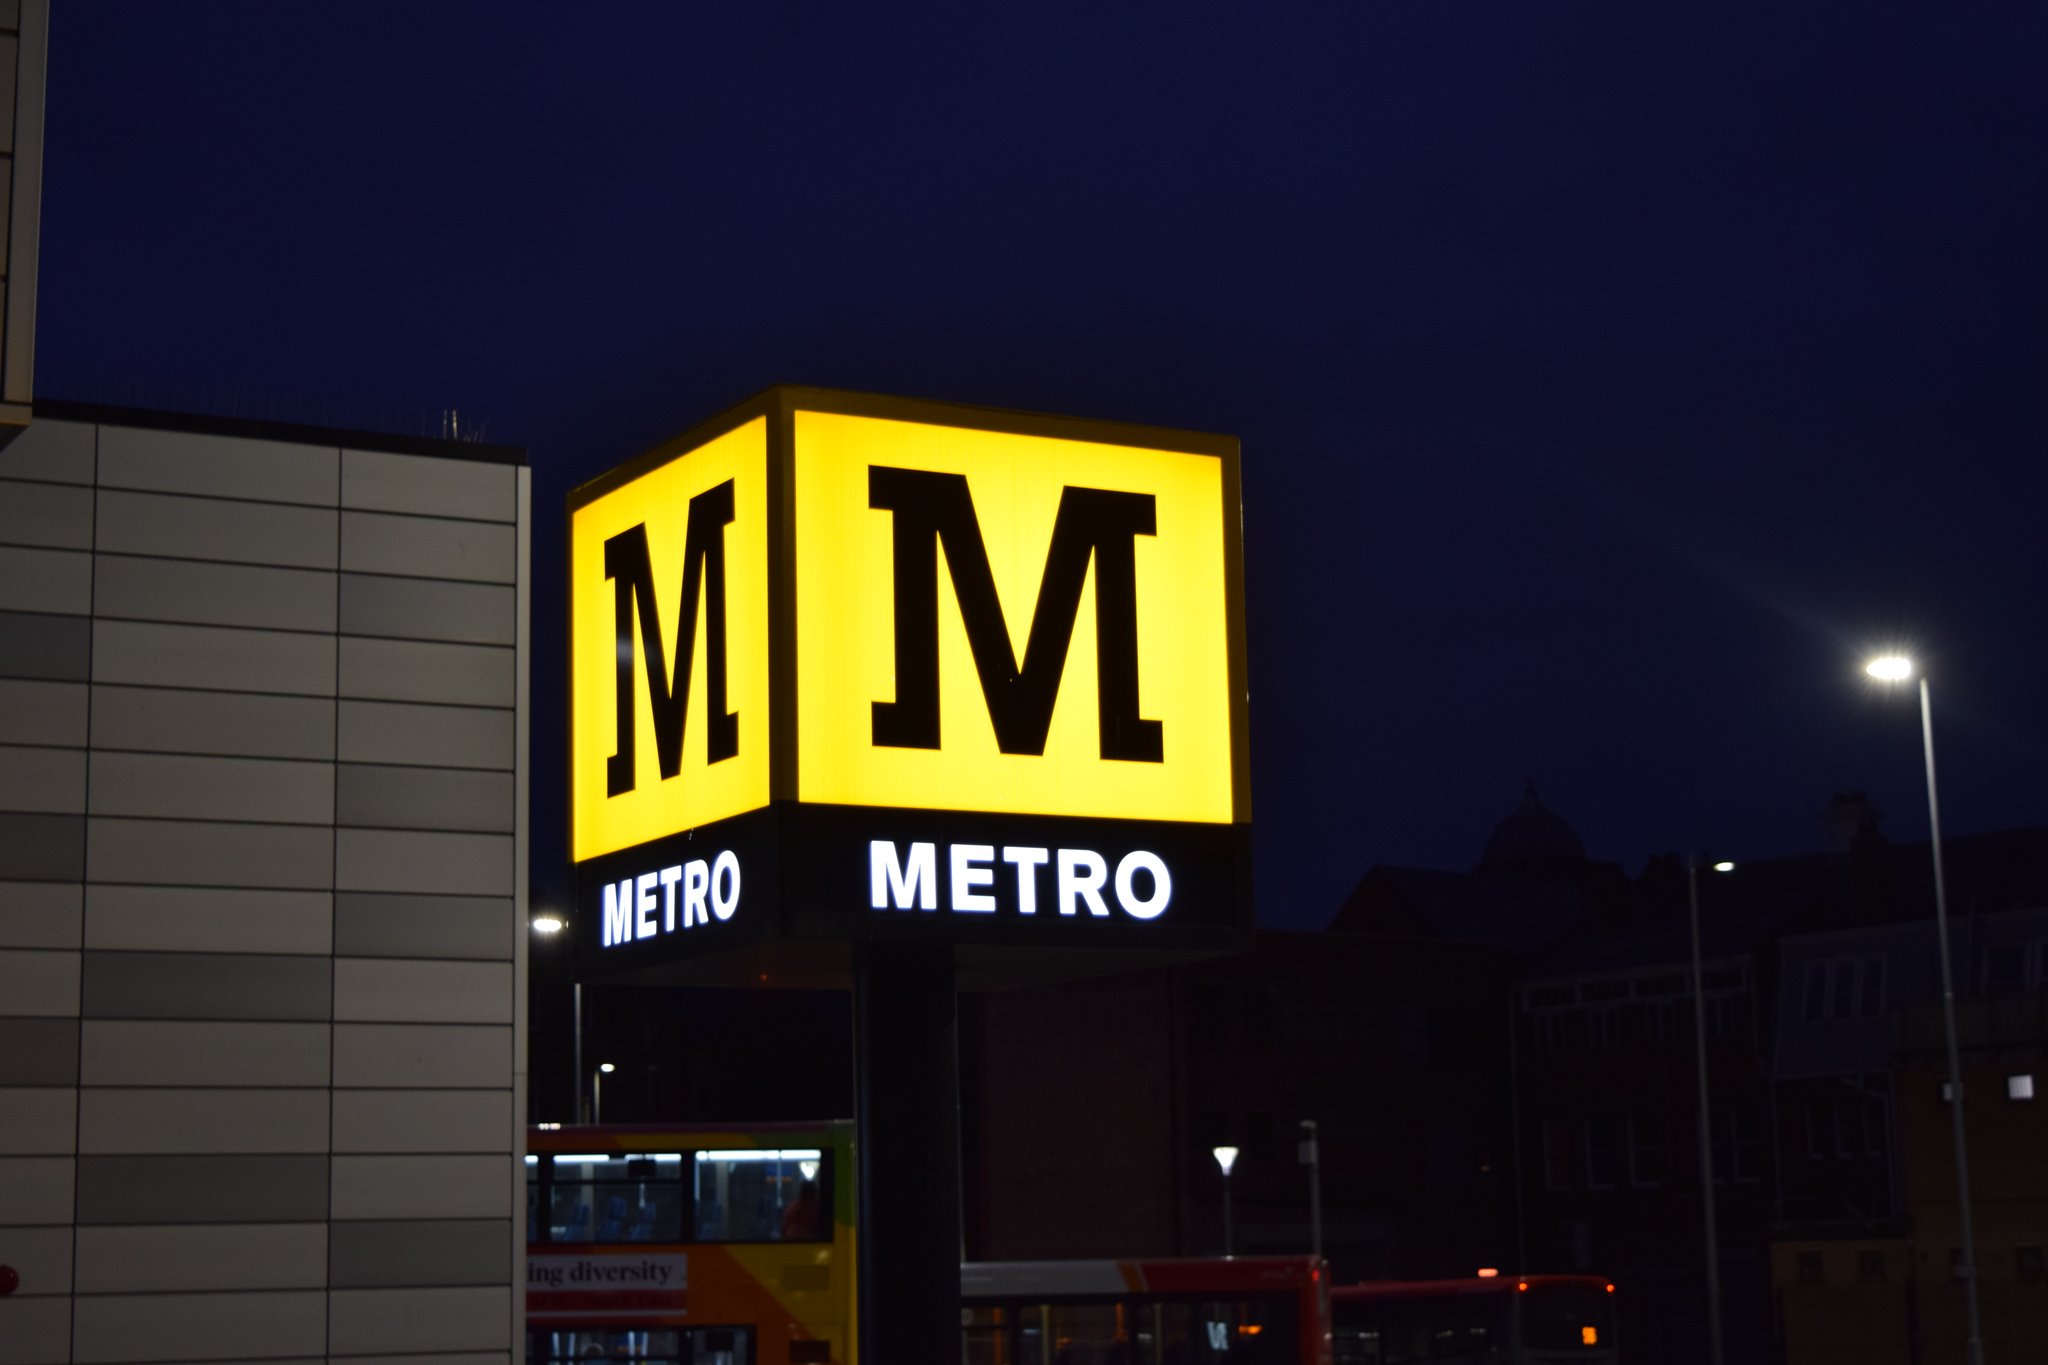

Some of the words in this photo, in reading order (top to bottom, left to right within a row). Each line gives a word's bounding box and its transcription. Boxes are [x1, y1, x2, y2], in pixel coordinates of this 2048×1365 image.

[604, 478, 738, 799] M
[868, 465, 1164, 763] M
[602, 849, 742, 947] METRO
[869, 839, 1173, 920] METRO
[570, 1260, 672, 1286] diversity
